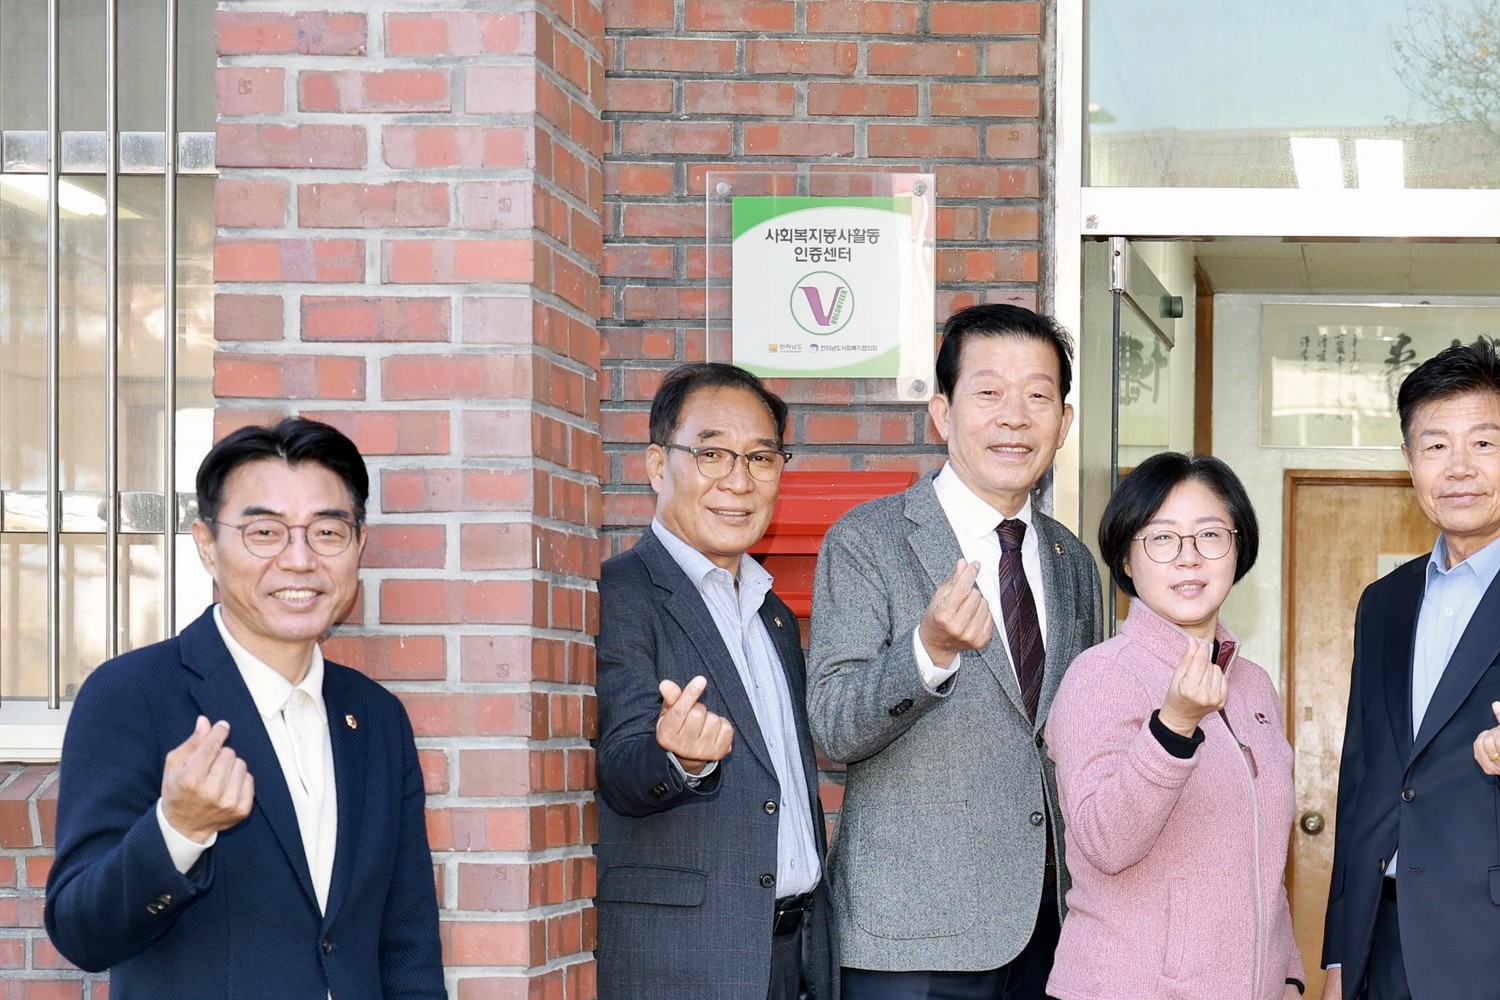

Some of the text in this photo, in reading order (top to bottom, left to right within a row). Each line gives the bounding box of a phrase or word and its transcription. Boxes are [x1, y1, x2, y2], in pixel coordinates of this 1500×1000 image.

[765, 228, 880, 244] 사회복지봉사활동
[794, 247, 852, 263] 인증센터
[831, 289, 848, 325] VOLUNTEER
